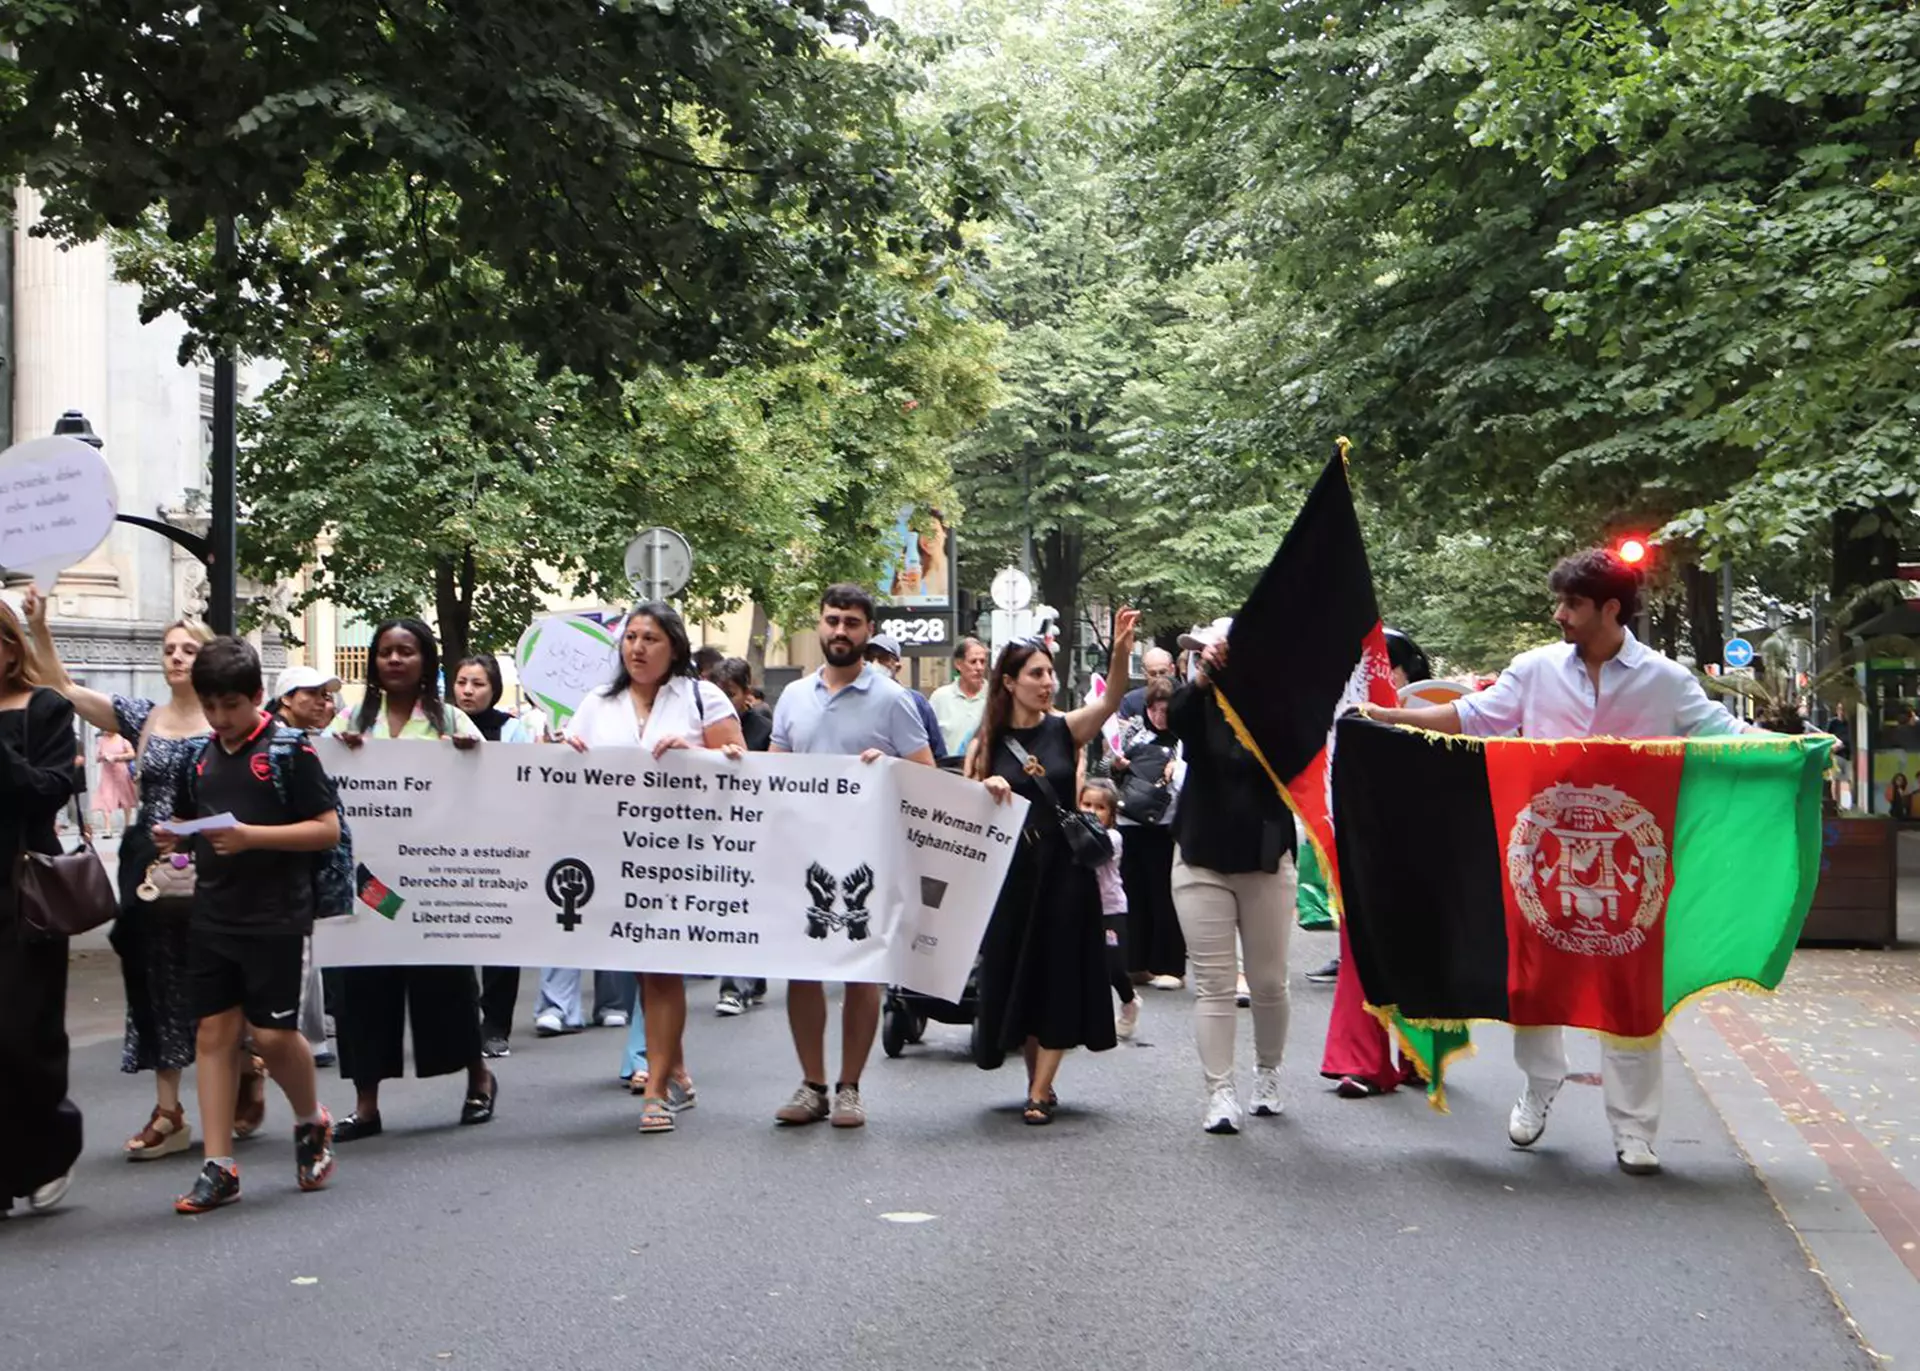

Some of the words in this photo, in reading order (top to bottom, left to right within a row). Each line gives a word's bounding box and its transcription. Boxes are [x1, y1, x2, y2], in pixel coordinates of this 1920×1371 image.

[333, 776, 398, 791] Woman
[404, 777, 432, 791] For
[516, 766, 532, 782] If
[539, 767, 577, 784] You
[583, 769, 635, 787] Were
[643, 772, 708, 792] Silent,
[715, 774, 762, 795] They
[768, 777, 829, 794] Would
[836, 779, 861, 795] Be
[616, 801, 723, 824] Forgotten.
[730, 806, 764, 823] Her
[900, 799, 928, 820] Free
[932, 808, 982, 835] Woman
[986, 824, 1013, 846] For
[398, 844, 456, 857] Derecho
[460, 848, 469, 857] a
[473, 847, 531, 859] estudiar
[622, 831, 681, 850] Voice
[687, 834, 705, 850] Is
[711, 835, 757, 853] Your
[906, 827, 988, 864] Afghanistan
[399, 875, 458, 888] Derecho
[461, 877, 474, 888] al
[479, 878, 528, 892] trabajo
[620, 861, 755, 887] Resposibility.
[685, 895, 750, 917] Forget
[412, 912, 471, 924] Libertad
[475, 914, 513, 924] como
[610, 922, 680, 944] Afghan
[687, 925, 760, 945] Woman
